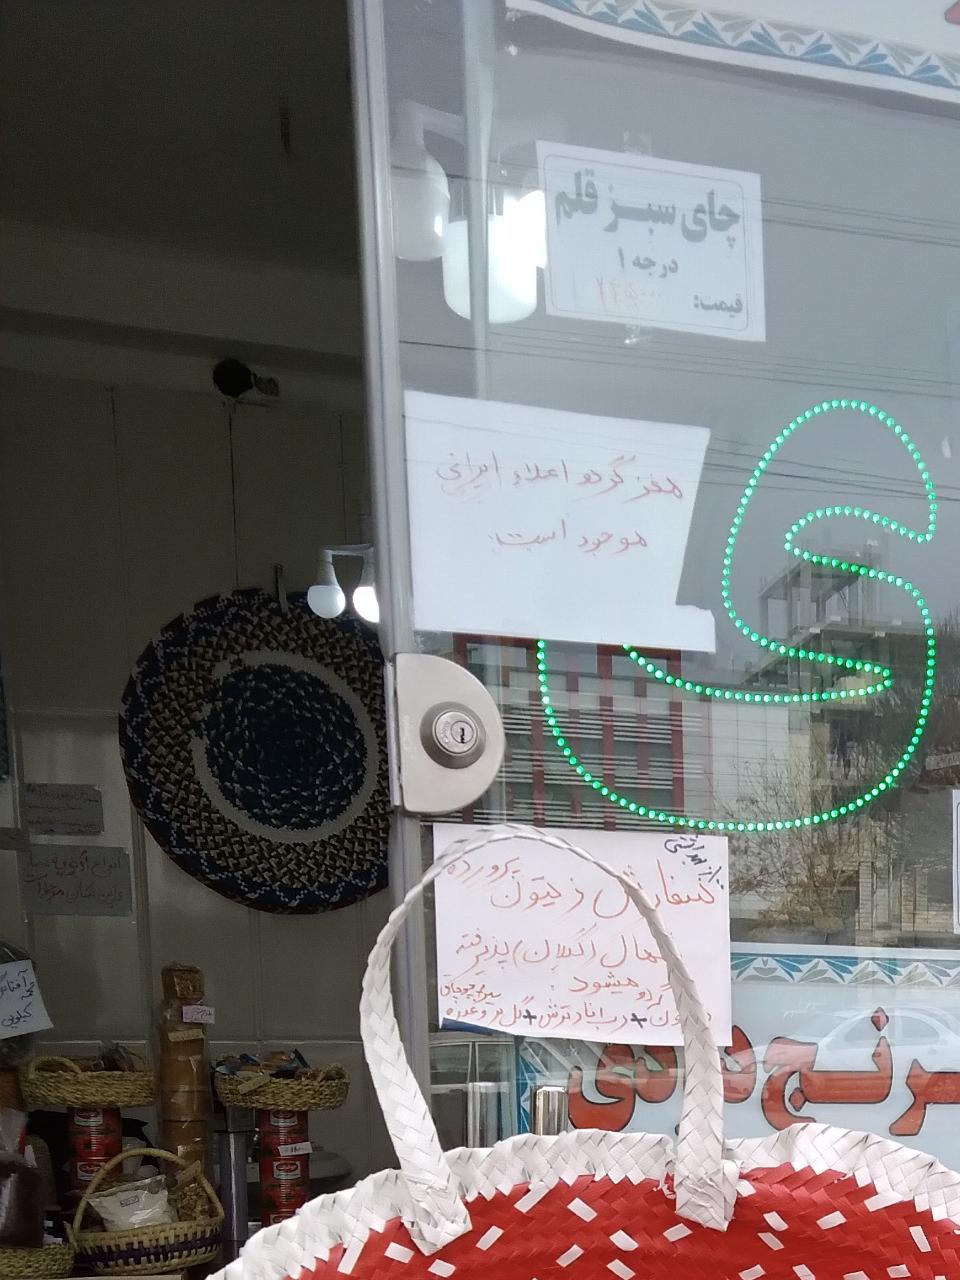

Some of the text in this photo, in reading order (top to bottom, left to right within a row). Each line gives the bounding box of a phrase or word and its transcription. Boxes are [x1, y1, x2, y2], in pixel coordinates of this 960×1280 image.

[554, 168, 742, 249] چای سبز قلم
[632, 255, 679, 279] درجه
[577, 530, 650, 558] موجود
[445, 854, 521, 892] پرورده
[488, 874, 587, 920] زیتون
[567, 1024, 757, 1133] ددی
